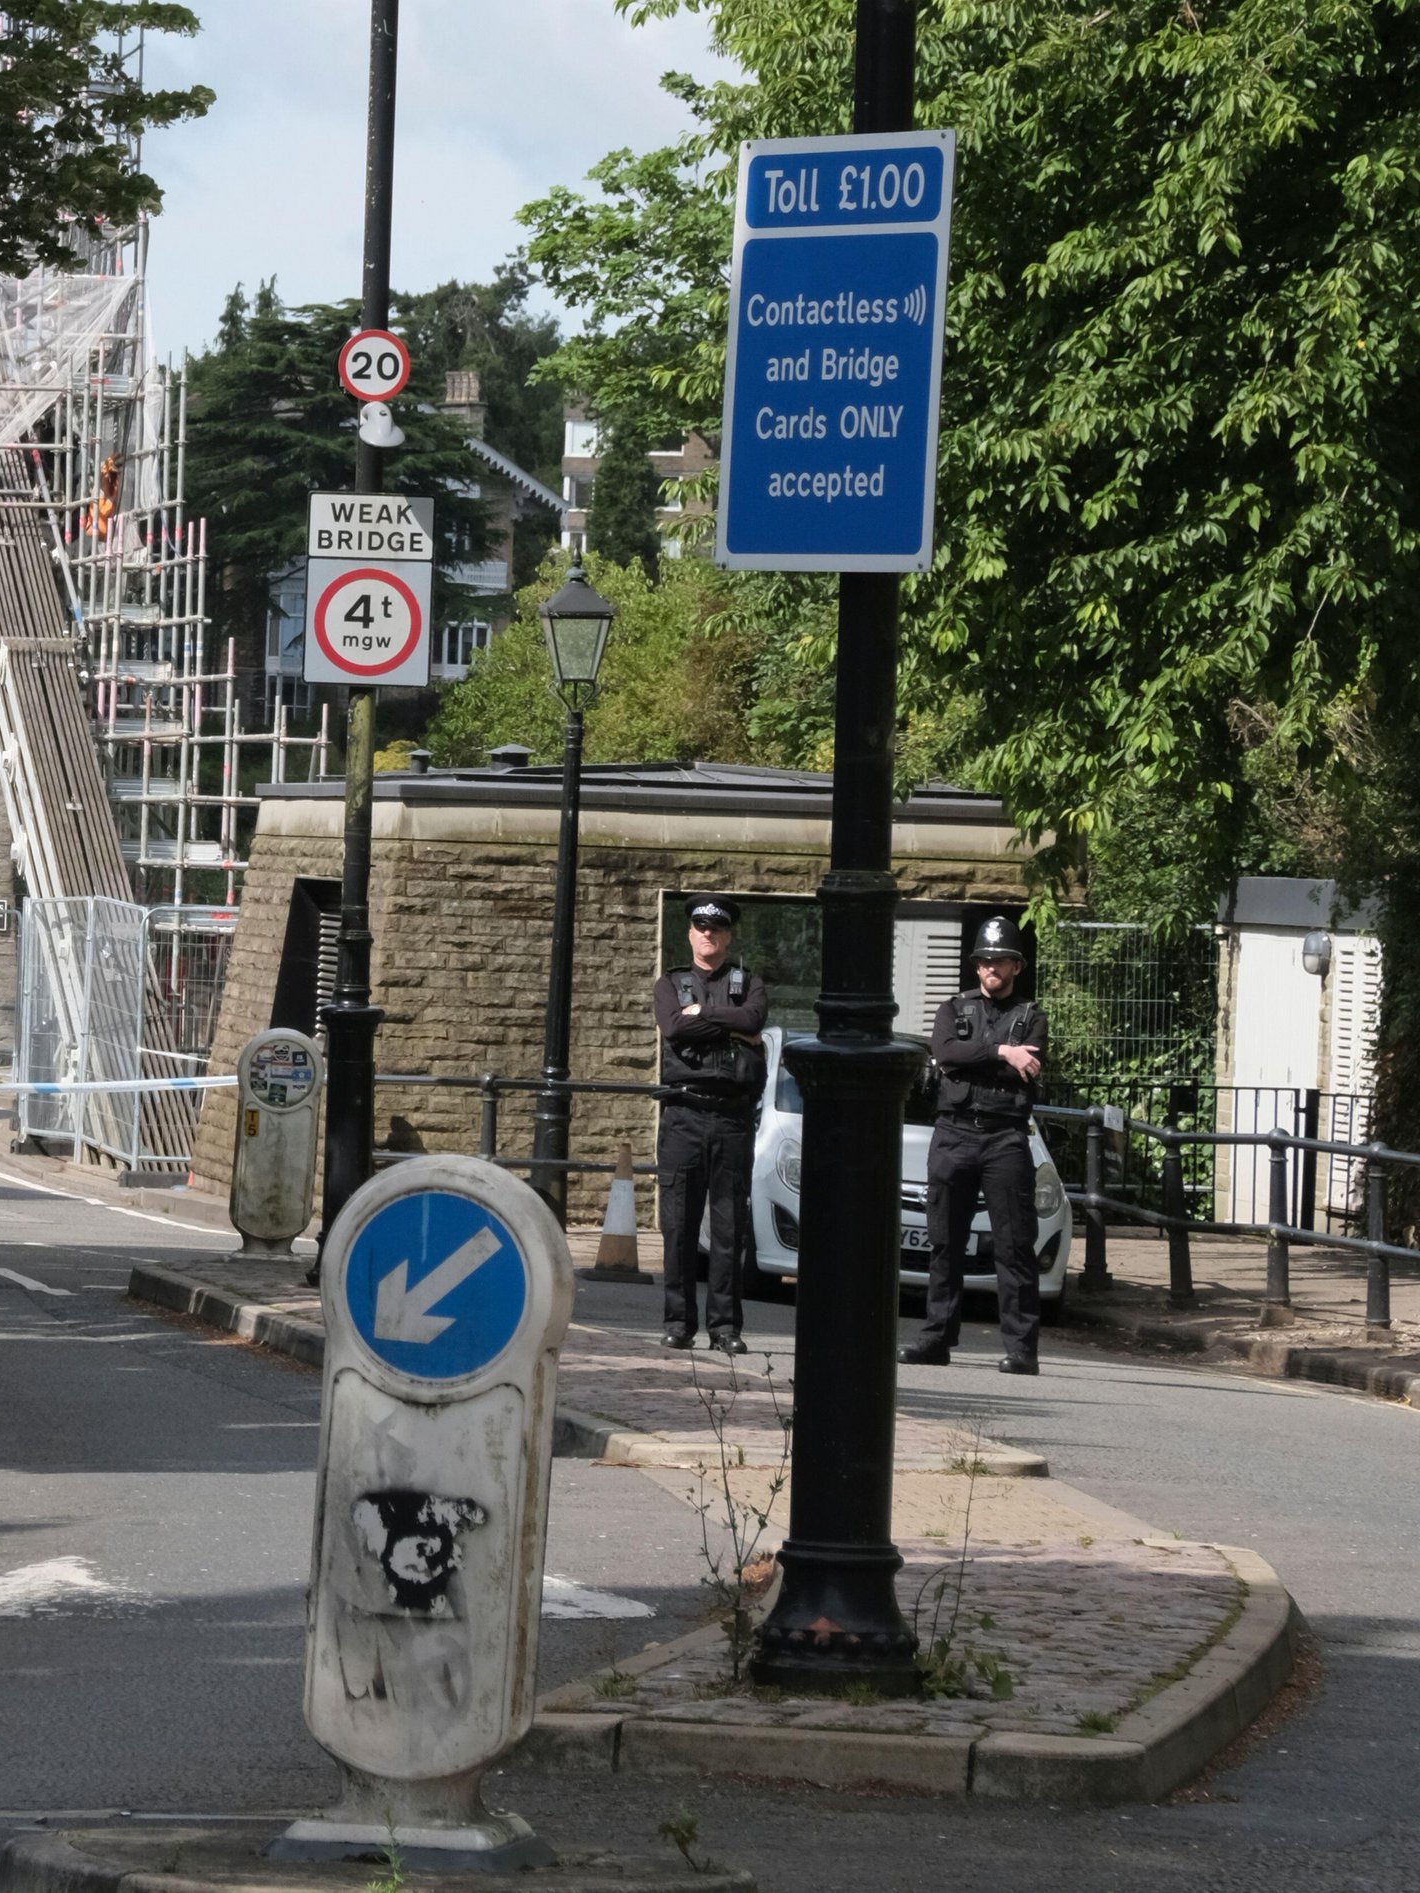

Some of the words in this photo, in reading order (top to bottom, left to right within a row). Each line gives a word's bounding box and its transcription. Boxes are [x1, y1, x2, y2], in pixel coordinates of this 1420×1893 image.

[764, 168, 820, 214] Toll
[838, 162, 925, 211] £1.00
[747, 291, 898, 327] Contactless
[351, 351, 400, 380] 20
[766, 349, 810, 382] and
[821, 347, 899, 387] Bridge
[756, 406, 827, 440] Cards
[840, 405, 905, 439] ONLY
[768, 464, 885, 503] accepted
[331, 502, 413, 525] WEAK
[318, 529, 424, 553] BRIDGE
[342, 634, 392, 651] mgw
